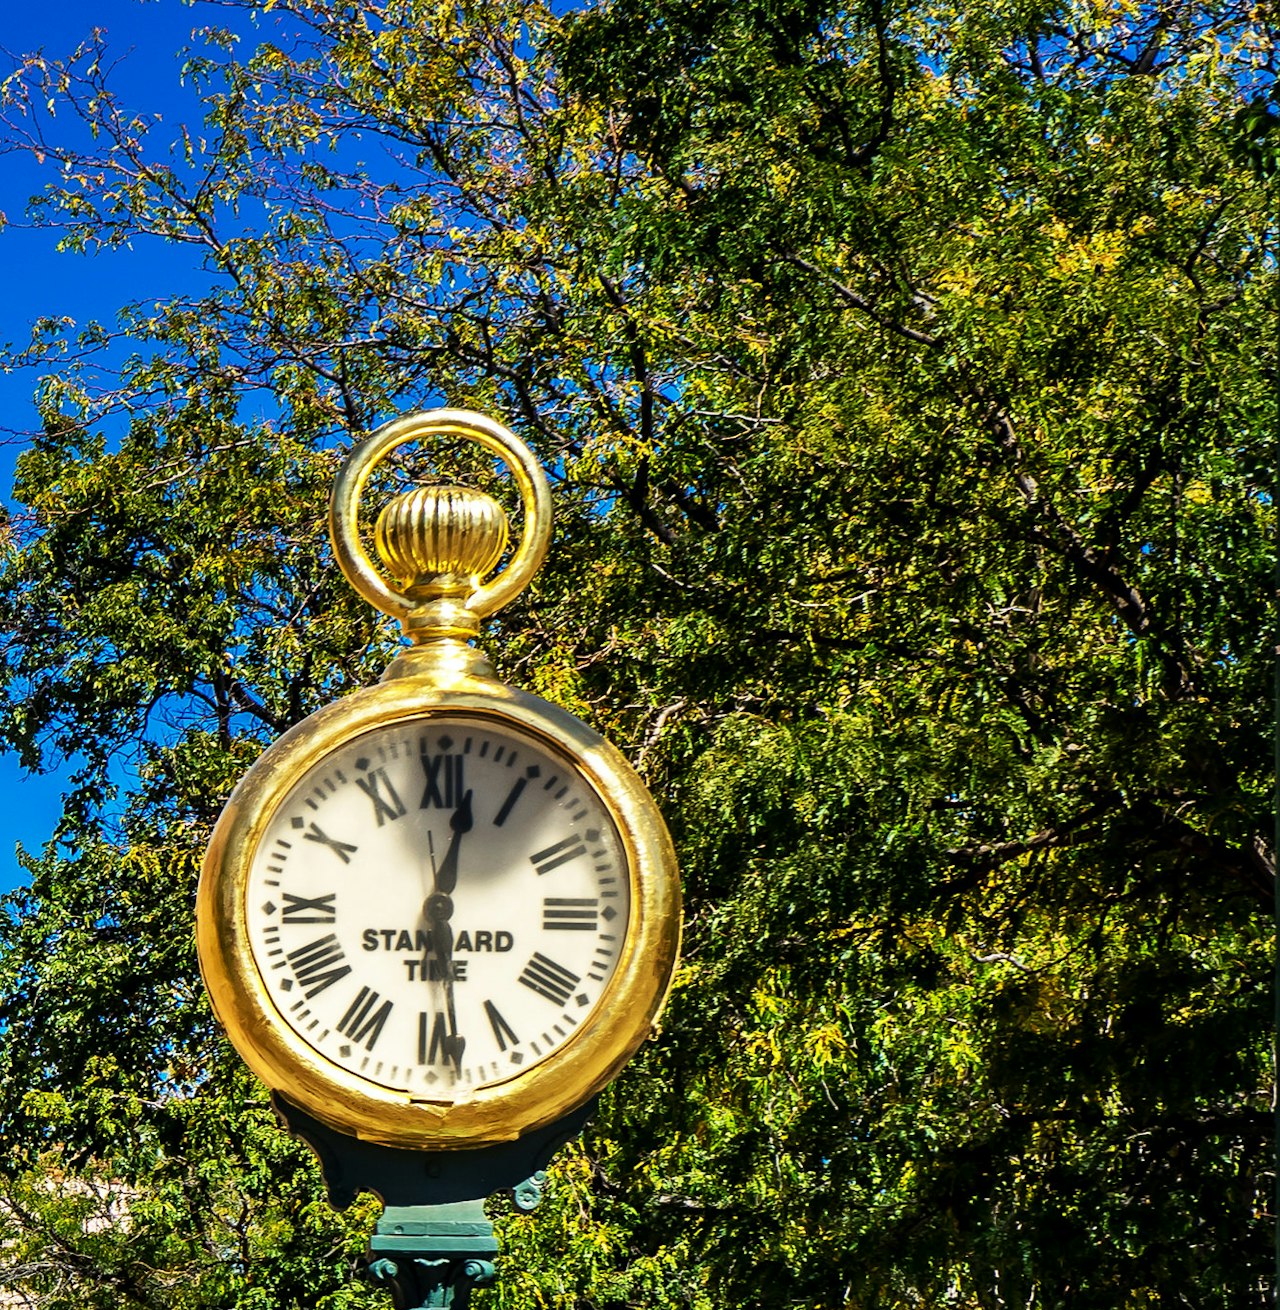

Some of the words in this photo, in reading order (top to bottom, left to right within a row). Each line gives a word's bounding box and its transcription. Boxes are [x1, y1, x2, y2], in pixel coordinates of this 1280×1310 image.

[355, 767, 407, 827] XI
[419, 754, 464, 809] XII
[303, 822, 358, 865] X
[530, 833, 587, 875] II
[282, 893, 336, 924] IX
[543, 898, 599, 931] III
[362, 929, 514, 952] STANARD
[286, 933, 352, 1000] VIII
[336, 986, 394, 1052] VII
[483, 1000, 520, 1052] V
